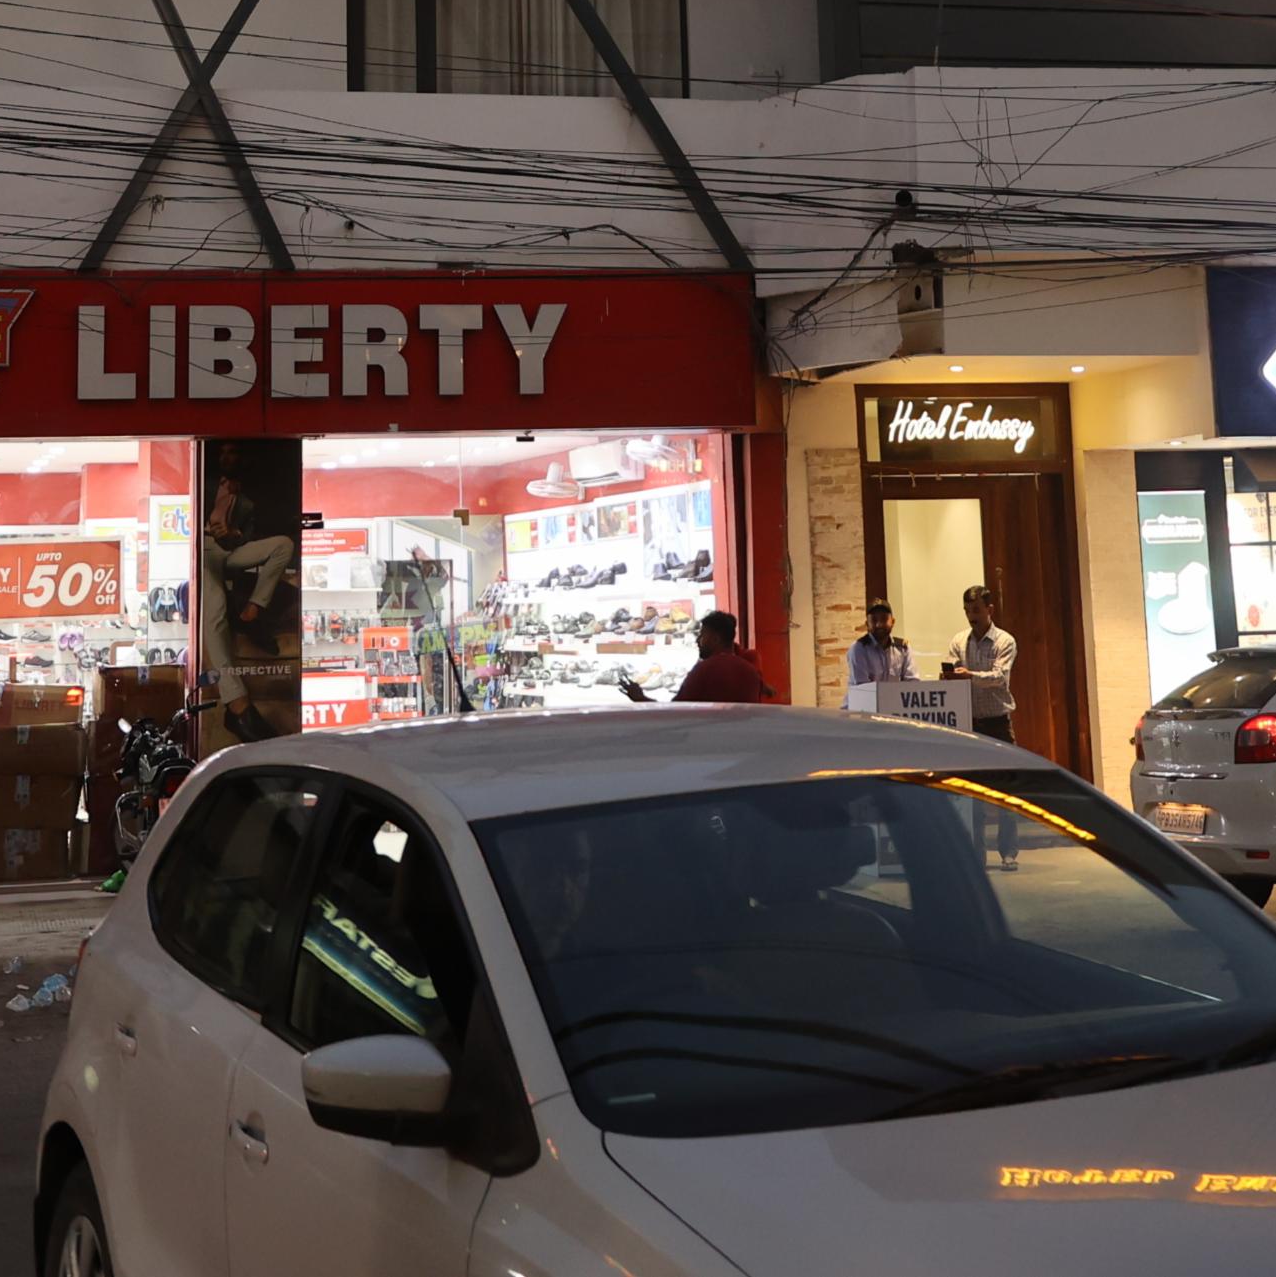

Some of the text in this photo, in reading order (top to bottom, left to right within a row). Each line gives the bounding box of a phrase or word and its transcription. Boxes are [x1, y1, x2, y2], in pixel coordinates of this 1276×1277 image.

[77, 303, 568, 400] LIBERTY
[888, 400, 1035, 454] Hotel Embassy
[36, 552, 62, 562] UPTO
[23, 562, 117, 608] 50%
[219, 665, 292, 676] ERSPECTIVE
[900, 691, 947, 708] VALET
[891, 712, 957, 728] RKING
